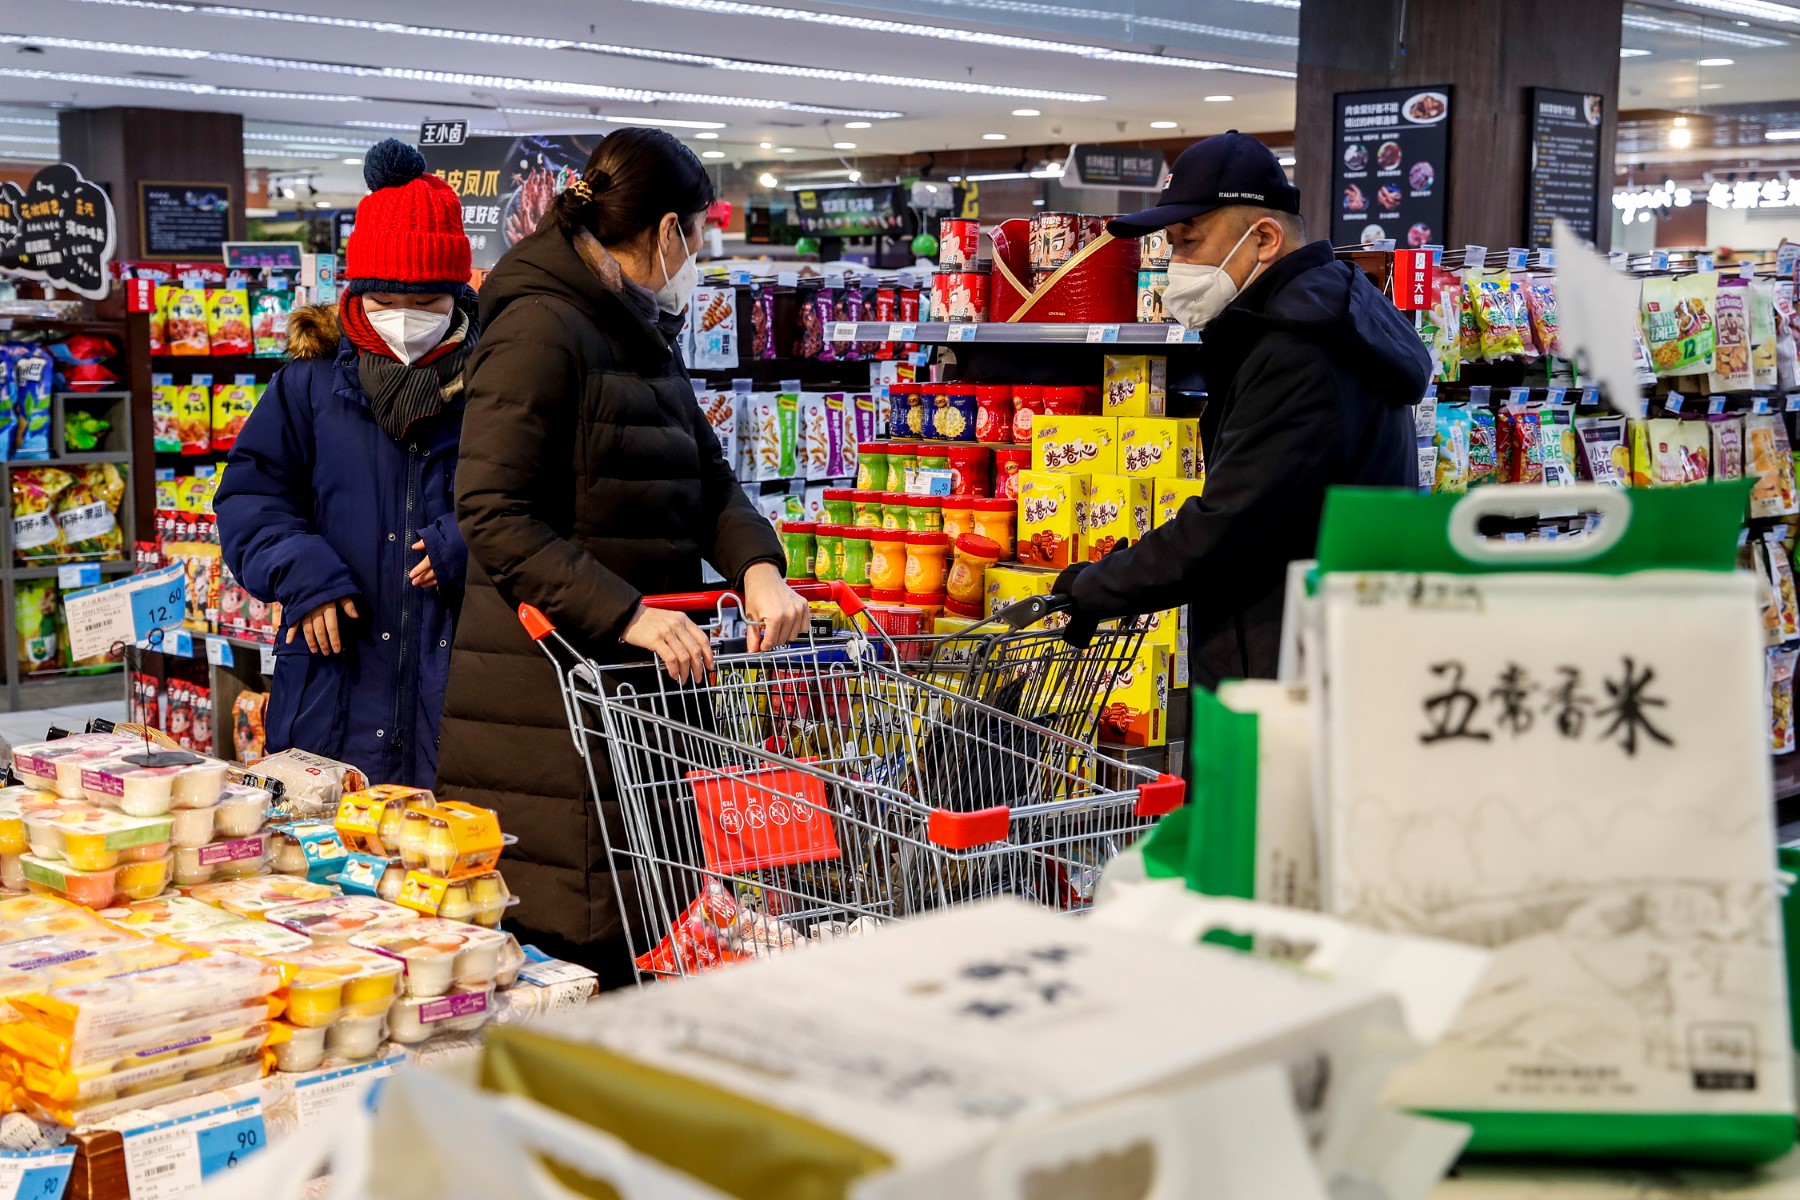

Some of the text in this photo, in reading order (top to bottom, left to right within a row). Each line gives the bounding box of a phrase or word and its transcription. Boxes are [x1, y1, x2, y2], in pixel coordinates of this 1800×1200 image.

[423, 123, 463, 143] 王小卤
[1240, 192, 1265, 202] HERITAGE
[462, 205, 500, 225] 更好吃
[1414, 271, 1425, 305] 放大镜
[1684, 338, 1697, 359] 12
[1542, 429, 1561, 444] 小米
[1045, 443, 1098, 467] 卷卷心
[1126, 446, 1162, 470] 卷卷心
[1590, 446, 1609, 460] 小米
[1025, 499, 1058, 522] 卷卷心
[1090, 504, 1118, 527] 卷卷心
[169, 588, 182, 604] 60
[1417, 655, 1675, 757] 五常香米
[237, 1129, 257, 1149] 90
[43, 1177, 59, 1195] 90
